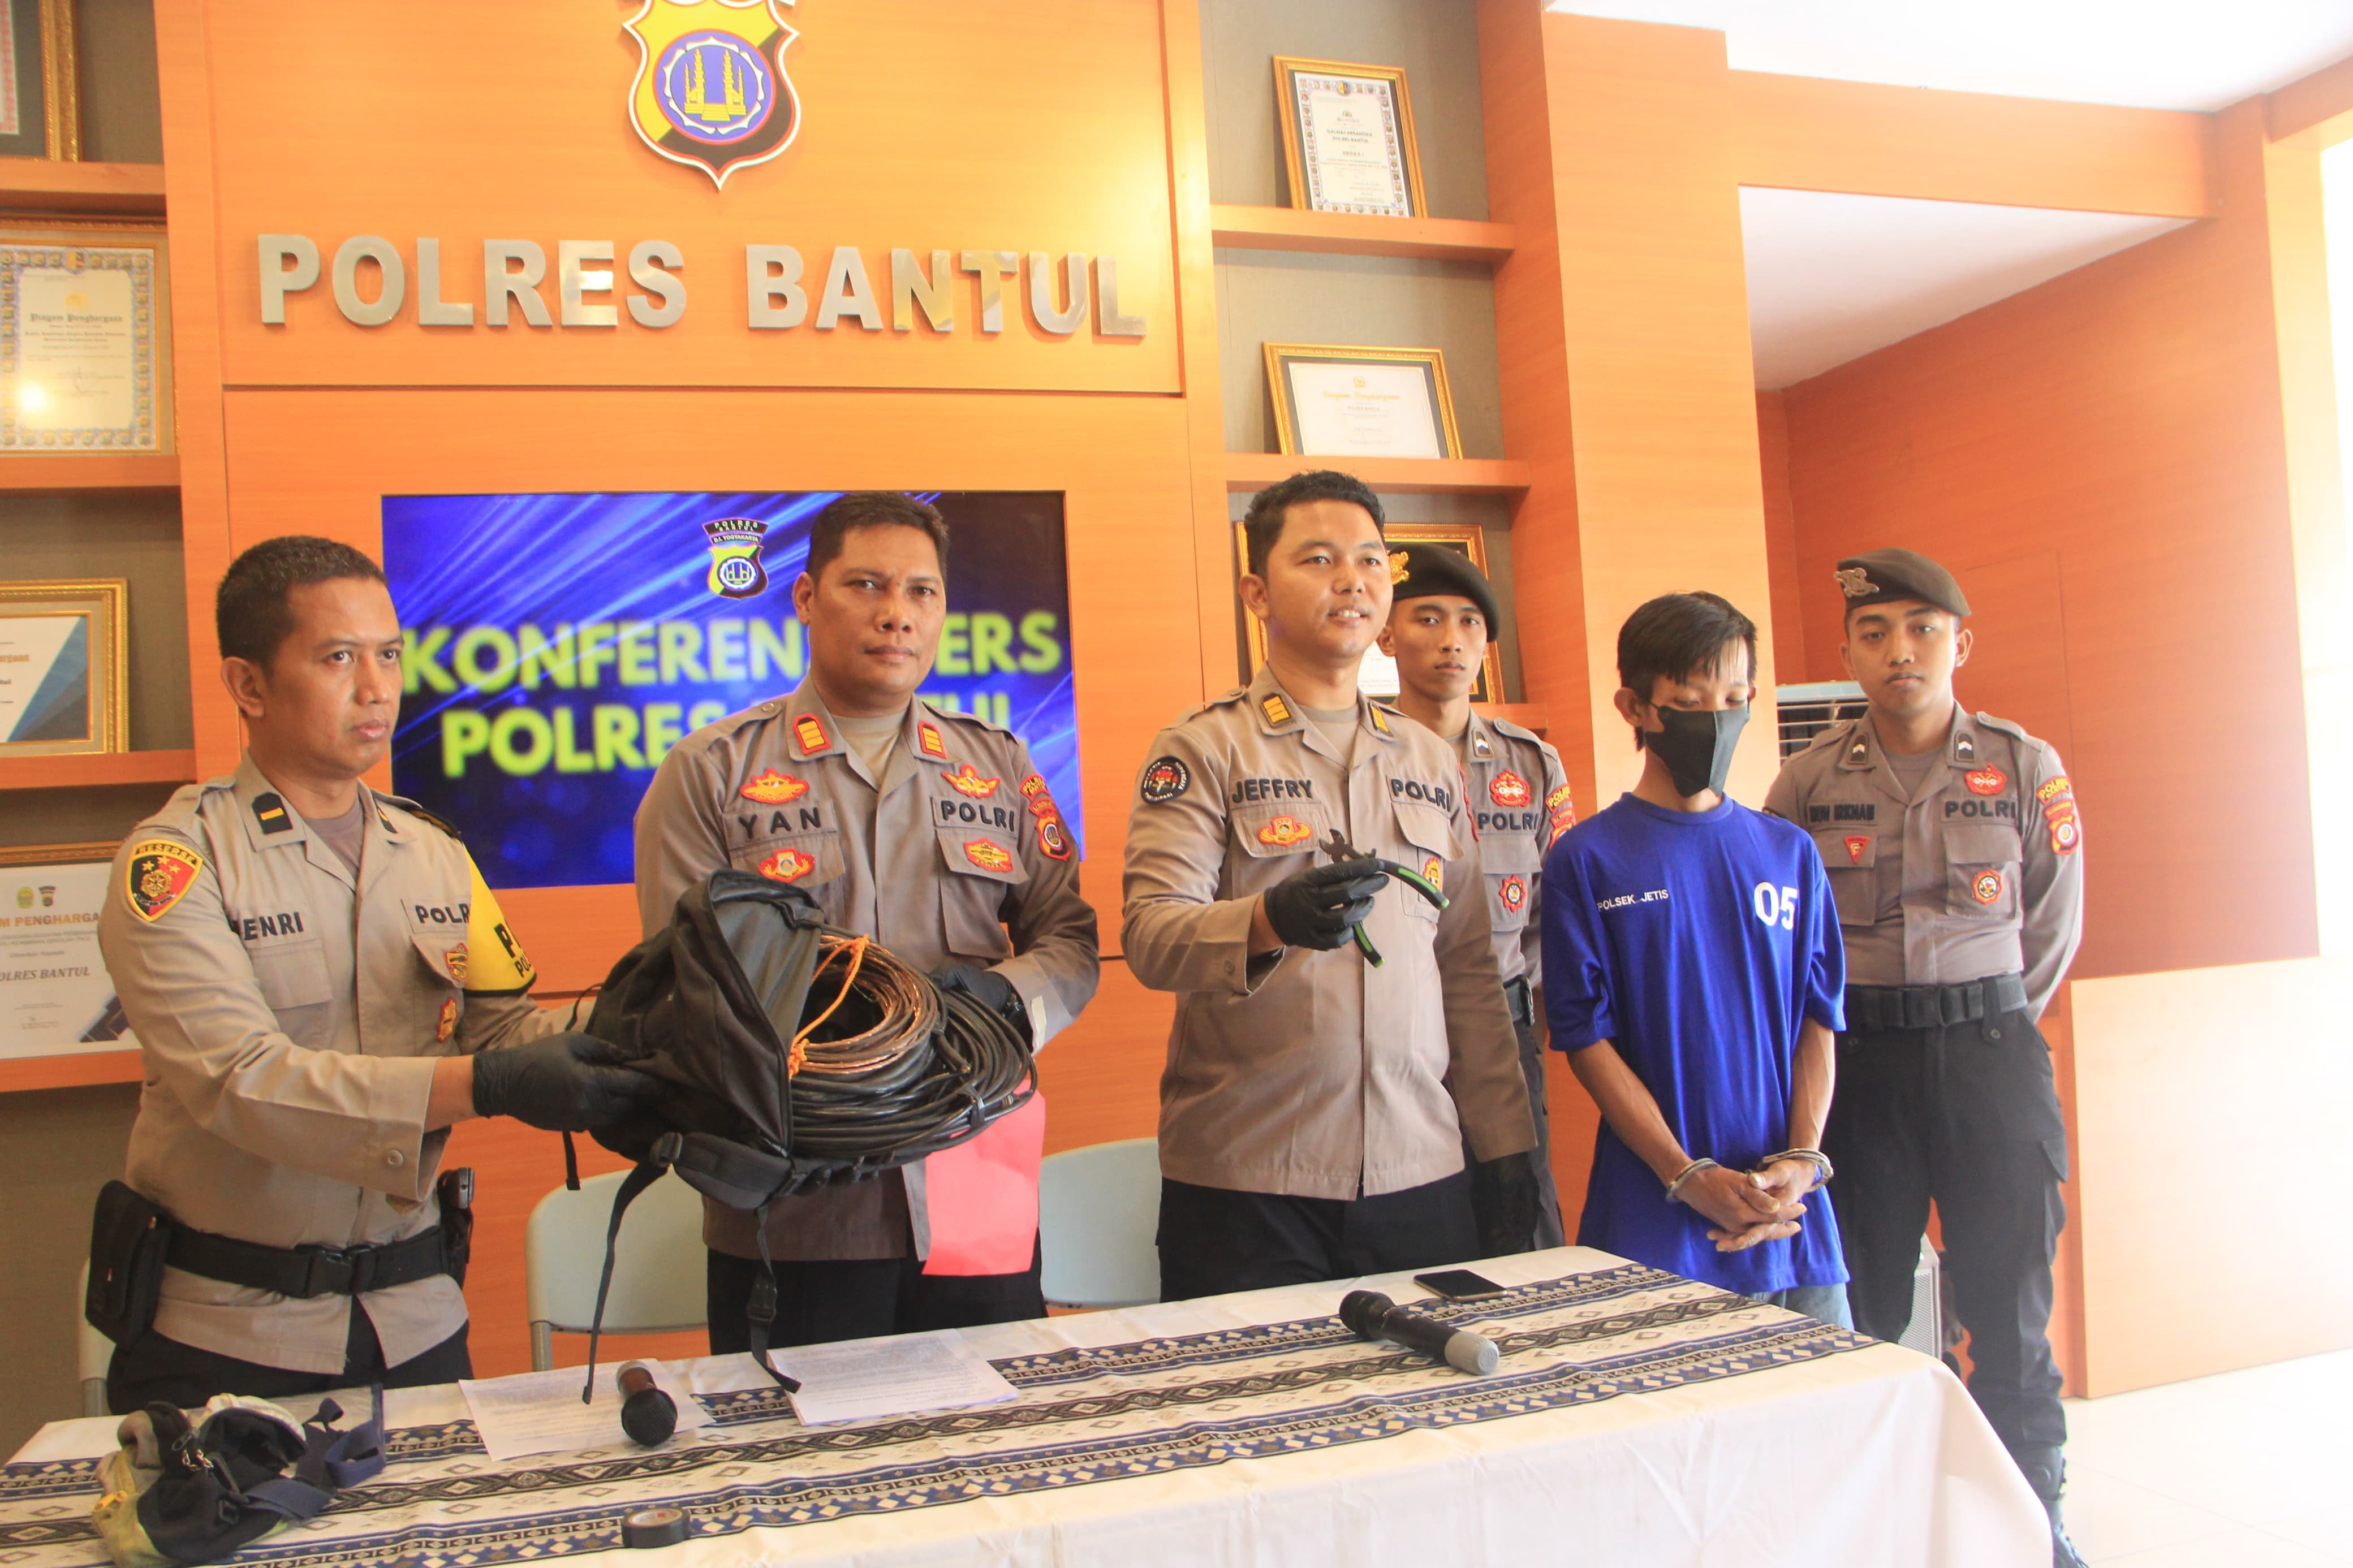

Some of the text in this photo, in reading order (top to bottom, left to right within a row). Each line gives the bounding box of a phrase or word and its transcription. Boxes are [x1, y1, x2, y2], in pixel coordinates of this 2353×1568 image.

[258, 234, 1147, 335] POLRES BANTUL
[714, 520, 759, 529] POLRES
[402, 611, 1062, 694] KONFEREN ERS
[1232, 779, 1312, 803] JEFFRY
[1391, 779, 1450, 812] POLRI
[941, 800, 1015, 832] POLRI
[1945, 800, 2016, 818] POLRI
[738, 807, 821, 840] YAN
[1477, 813, 1539, 830] POLRI
[1597, 889, 1669, 912] POLSEK JETIS
[1754, 881, 1798, 930] 05
[15, 912, 100, 927] PENGHARGA
[415, 903, 471, 923] POLR
[0, 966, 90, 982] OLRES BANTUL
